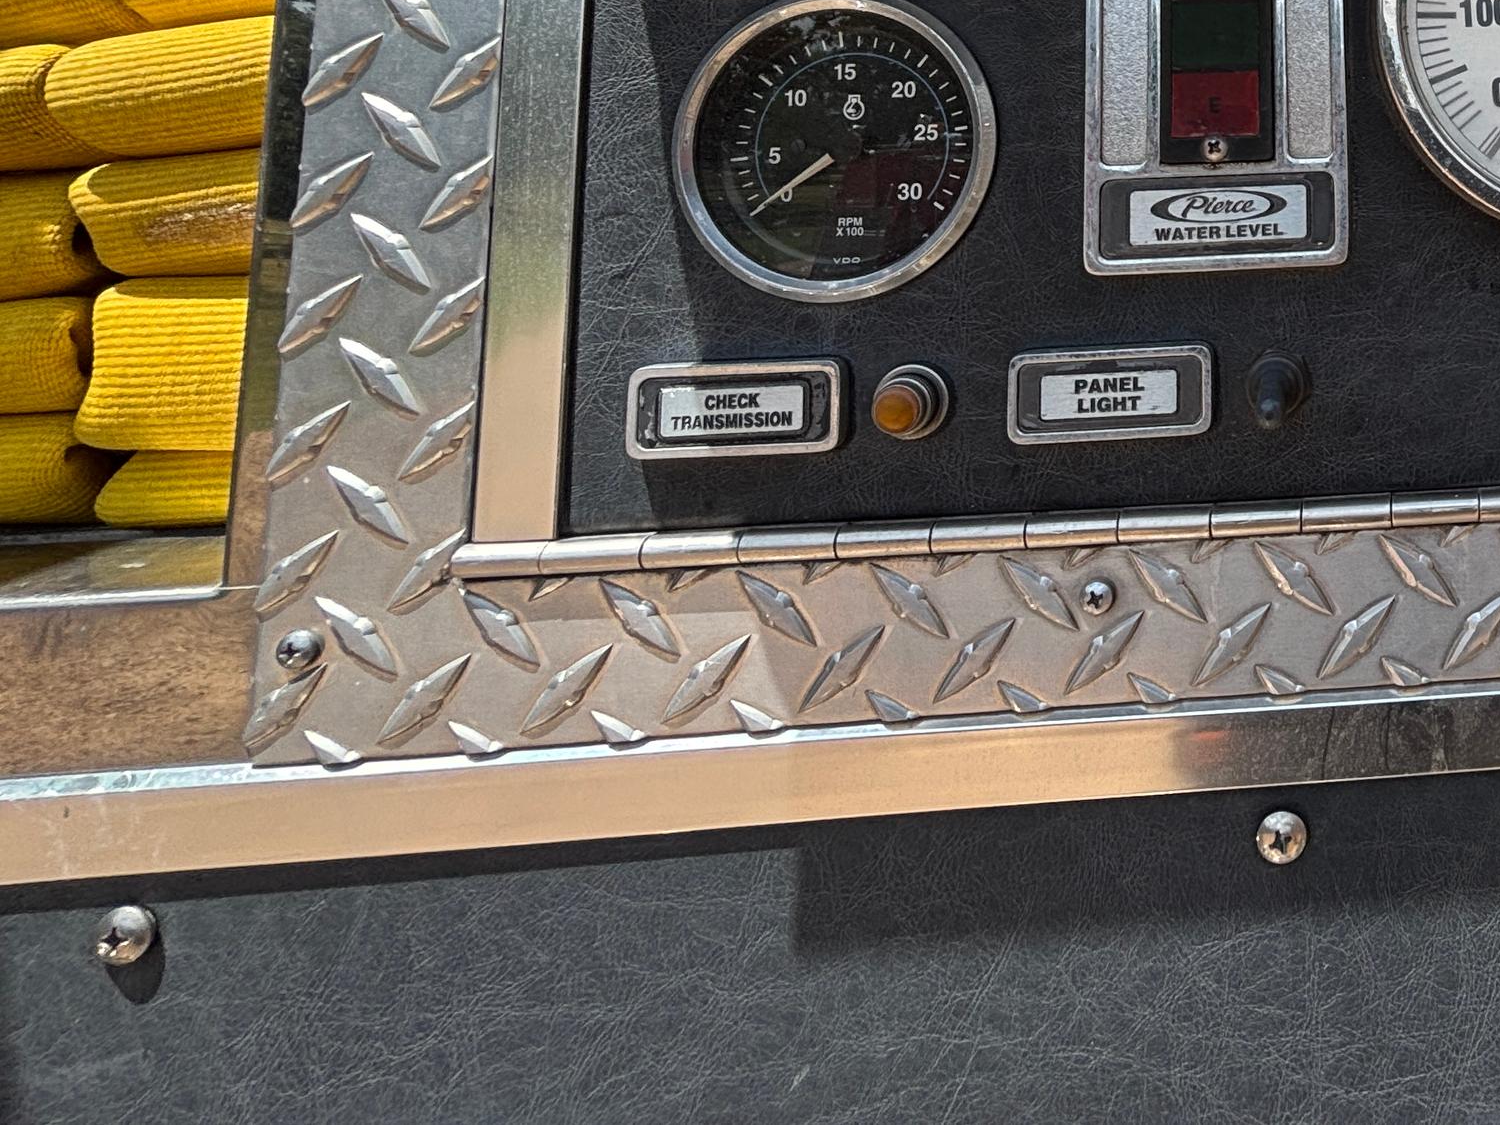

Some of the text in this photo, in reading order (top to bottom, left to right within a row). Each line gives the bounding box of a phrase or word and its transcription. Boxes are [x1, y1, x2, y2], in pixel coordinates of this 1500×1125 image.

[834, 63, 856, 80] 15
[785, 89, 807, 107] 10
[891, 81, 916, 98] 20
[1209, 97, 1221, 113] E
[913, 124, 939, 141] 25
[768, 147, 781, 164] 5
[897, 183, 923, 200] 30
[1181, 194, 1257, 218] Pierce
[838, 217, 863, 227] RPM
[1154, 223, 1284, 242] WATER LEVEL
[1074, 377, 1145, 394] PANEL
[704, 393, 760, 410] CHECK
[1077, 396, 1141, 413] LIGHT
[671, 411, 793, 430] TRANSMISSION
